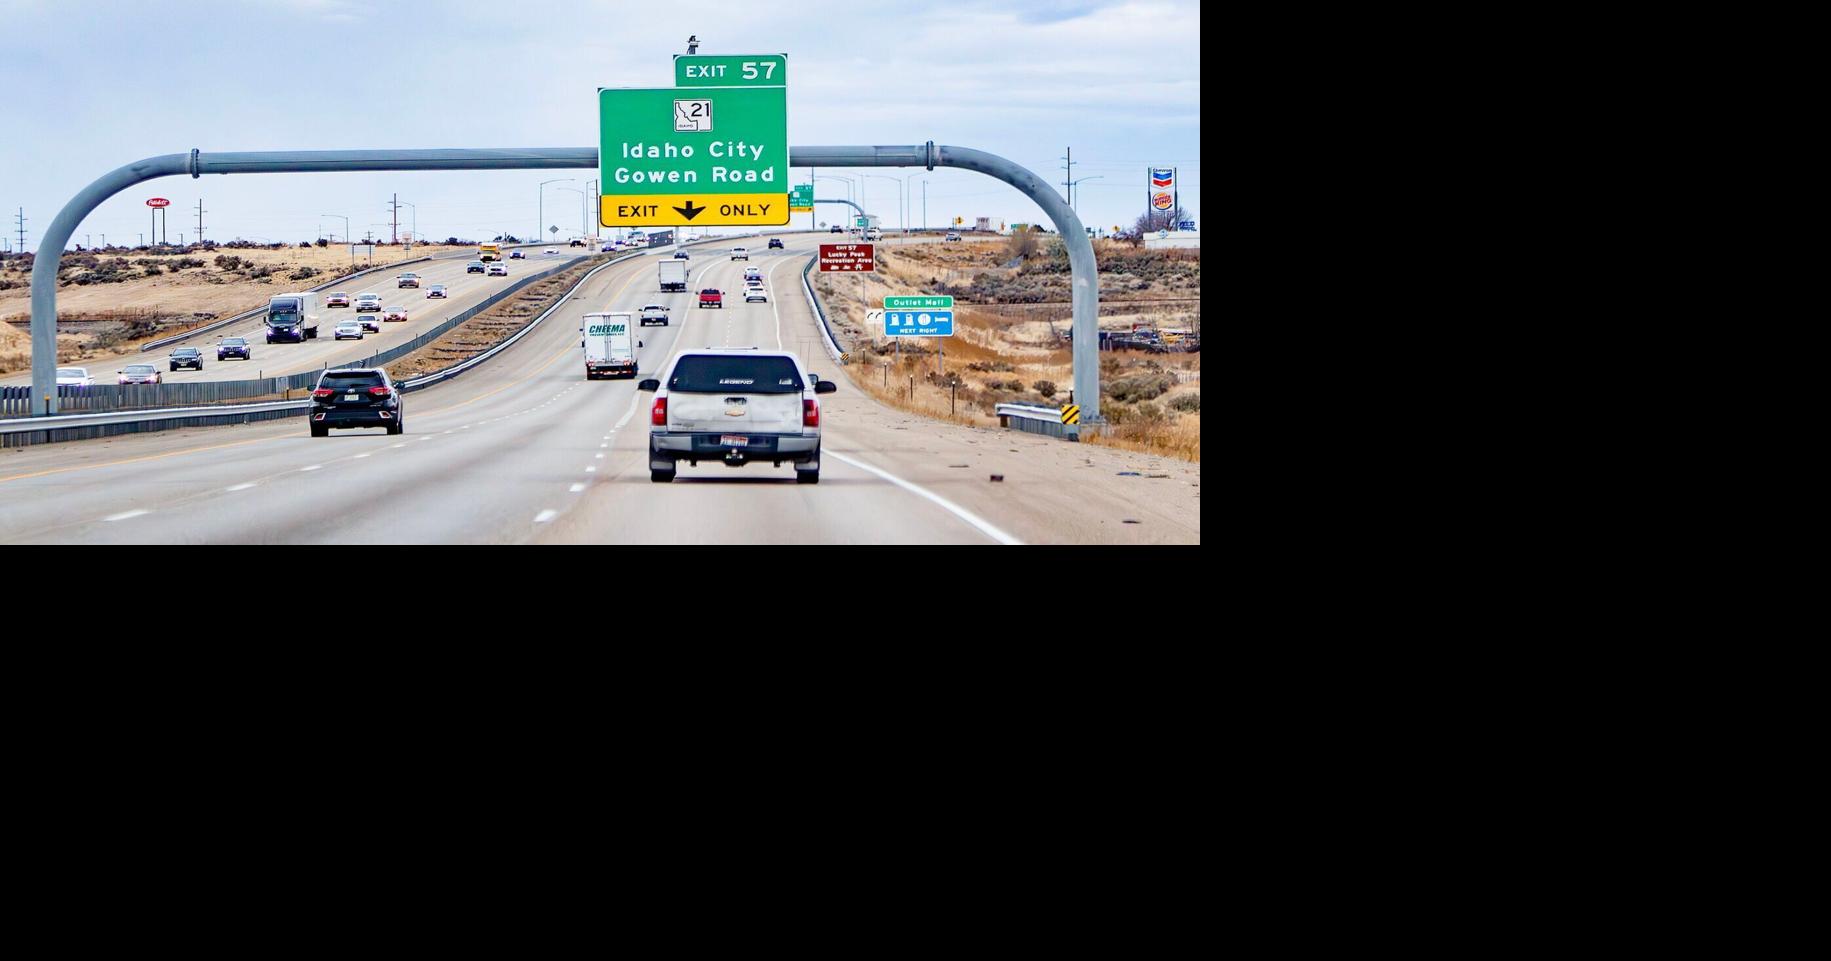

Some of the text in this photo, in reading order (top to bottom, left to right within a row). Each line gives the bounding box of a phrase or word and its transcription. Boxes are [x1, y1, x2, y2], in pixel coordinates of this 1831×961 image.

[686, 62, 776, 79] EXIT 57
[691, 102, 709, 117] 21
[622, 141, 764, 161] Idaho City
[615, 166, 774, 183] Gowen Road
[618, 204, 770, 217] EXIT ONLY
[589, 324, 625, 333] CHEEMA
